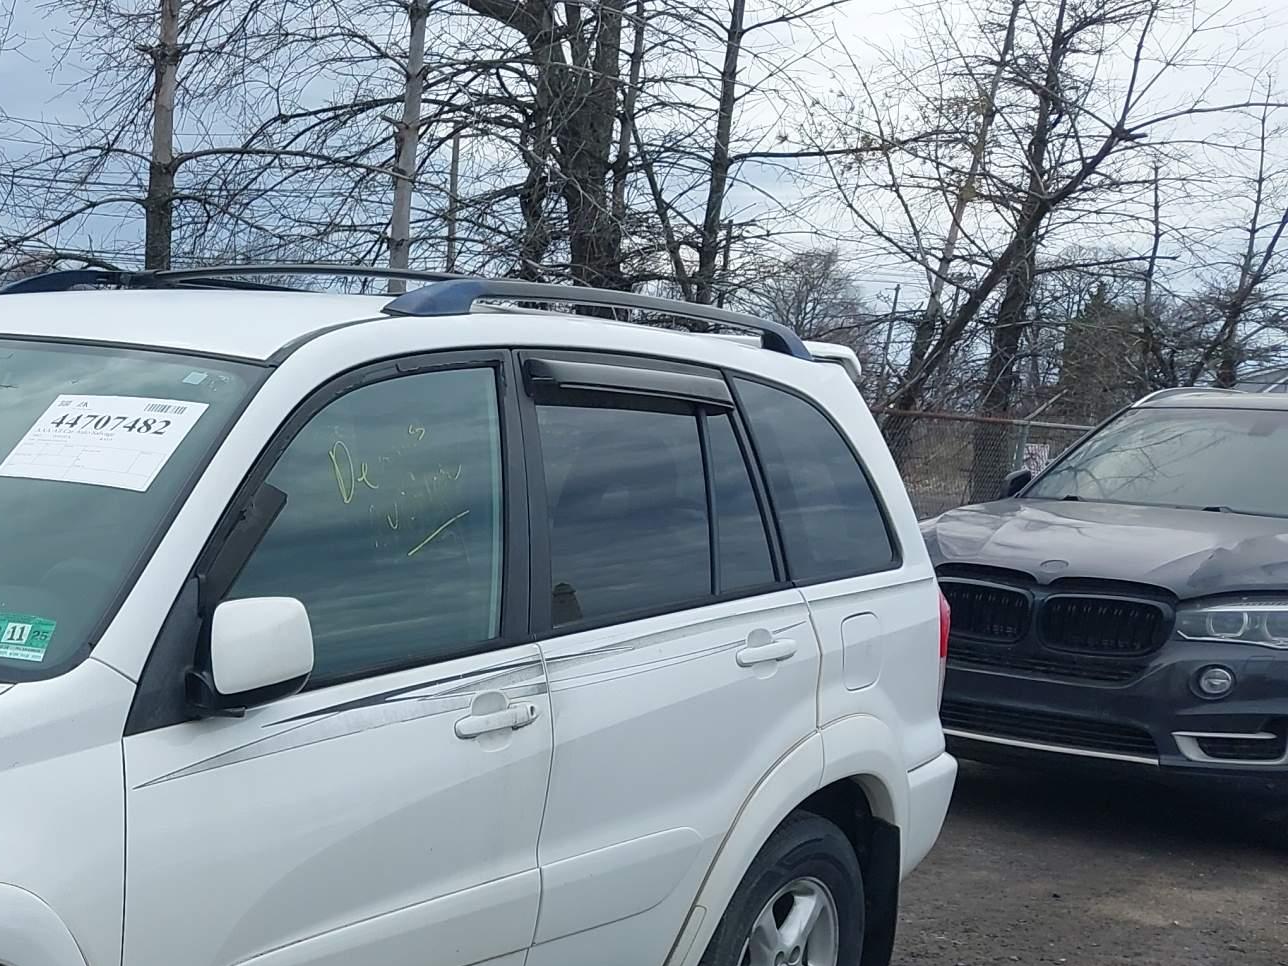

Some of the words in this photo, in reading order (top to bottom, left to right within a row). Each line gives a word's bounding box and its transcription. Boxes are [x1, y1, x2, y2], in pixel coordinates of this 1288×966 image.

[50, 413, 172, 435] 44707482
[6, 625, 26, 641] 11
[31, 630, 49, 641] 25
